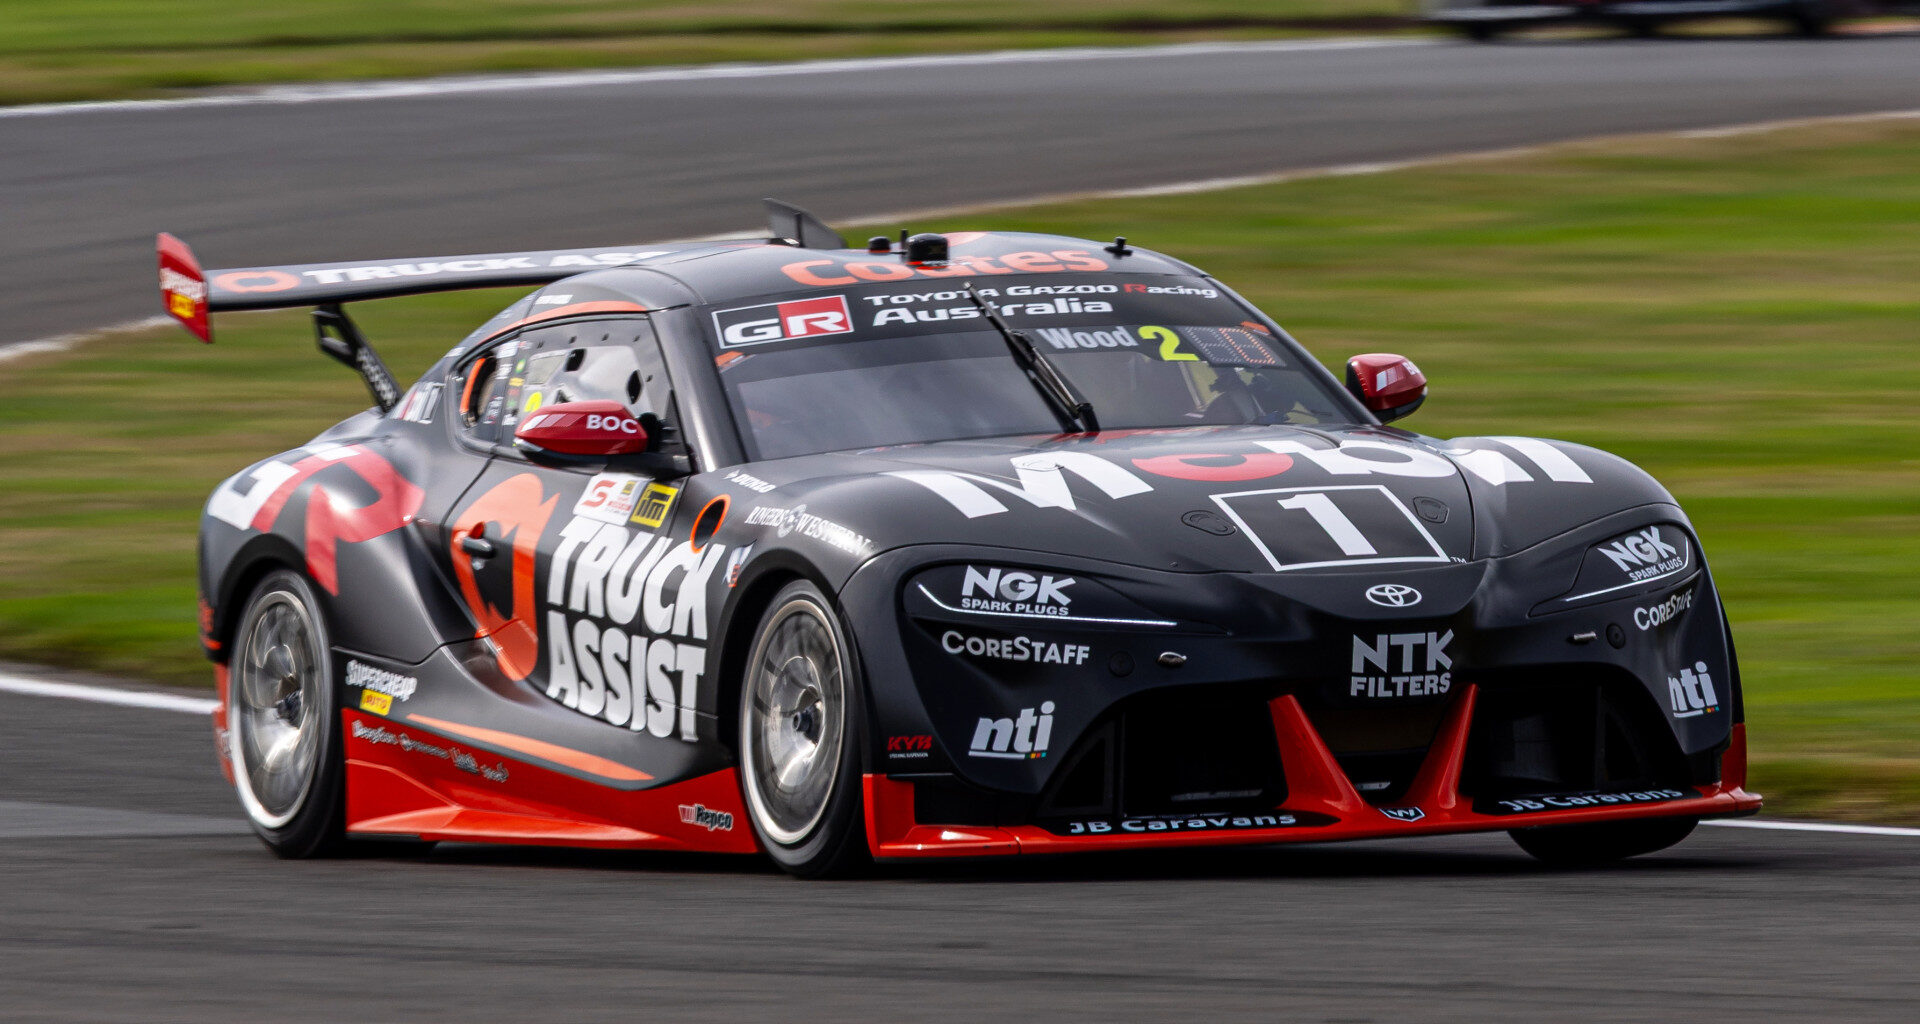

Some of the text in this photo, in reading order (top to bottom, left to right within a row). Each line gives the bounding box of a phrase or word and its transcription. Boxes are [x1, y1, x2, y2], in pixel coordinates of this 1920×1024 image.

[303, 257, 539, 284] TRUCK
[863, 283, 1219, 306] TOYOTA GAZOO Racing
[872, 297, 1114, 327] Australia
[724, 311, 846, 344] GR
[1036, 326, 1139, 349] Wood
[1137, 325, 1200, 361] 2
[586, 414, 638, 434] BOC
[880, 437, 1594, 519] Mobil
[745, 506, 791, 527] RINGERS
[1277, 492, 1379, 556] 1
[1597, 526, 1676, 572] NGK
[547, 516, 726, 640] TRUCK
[1629, 556, 1683, 582] SPARK PLUGS
[962, 565, 1077, 606] NGK
[961, 597, 1069, 616] SPARK PLUGS
[1352, 628, 1454, 674] NTK
[546, 610, 707, 742] ASSIST
[1350, 672, 1451, 697] FILTERS
[1668, 661, 1718, 712] nti
[970, 701, 1055, 753] nti
[887, 735, 933, 751] KYB
[1499, 787, 1683, 811] JB Caravans
[696, 805, 733, 831] Repco
[1070, 814, 1297, 833] JB Caravans
